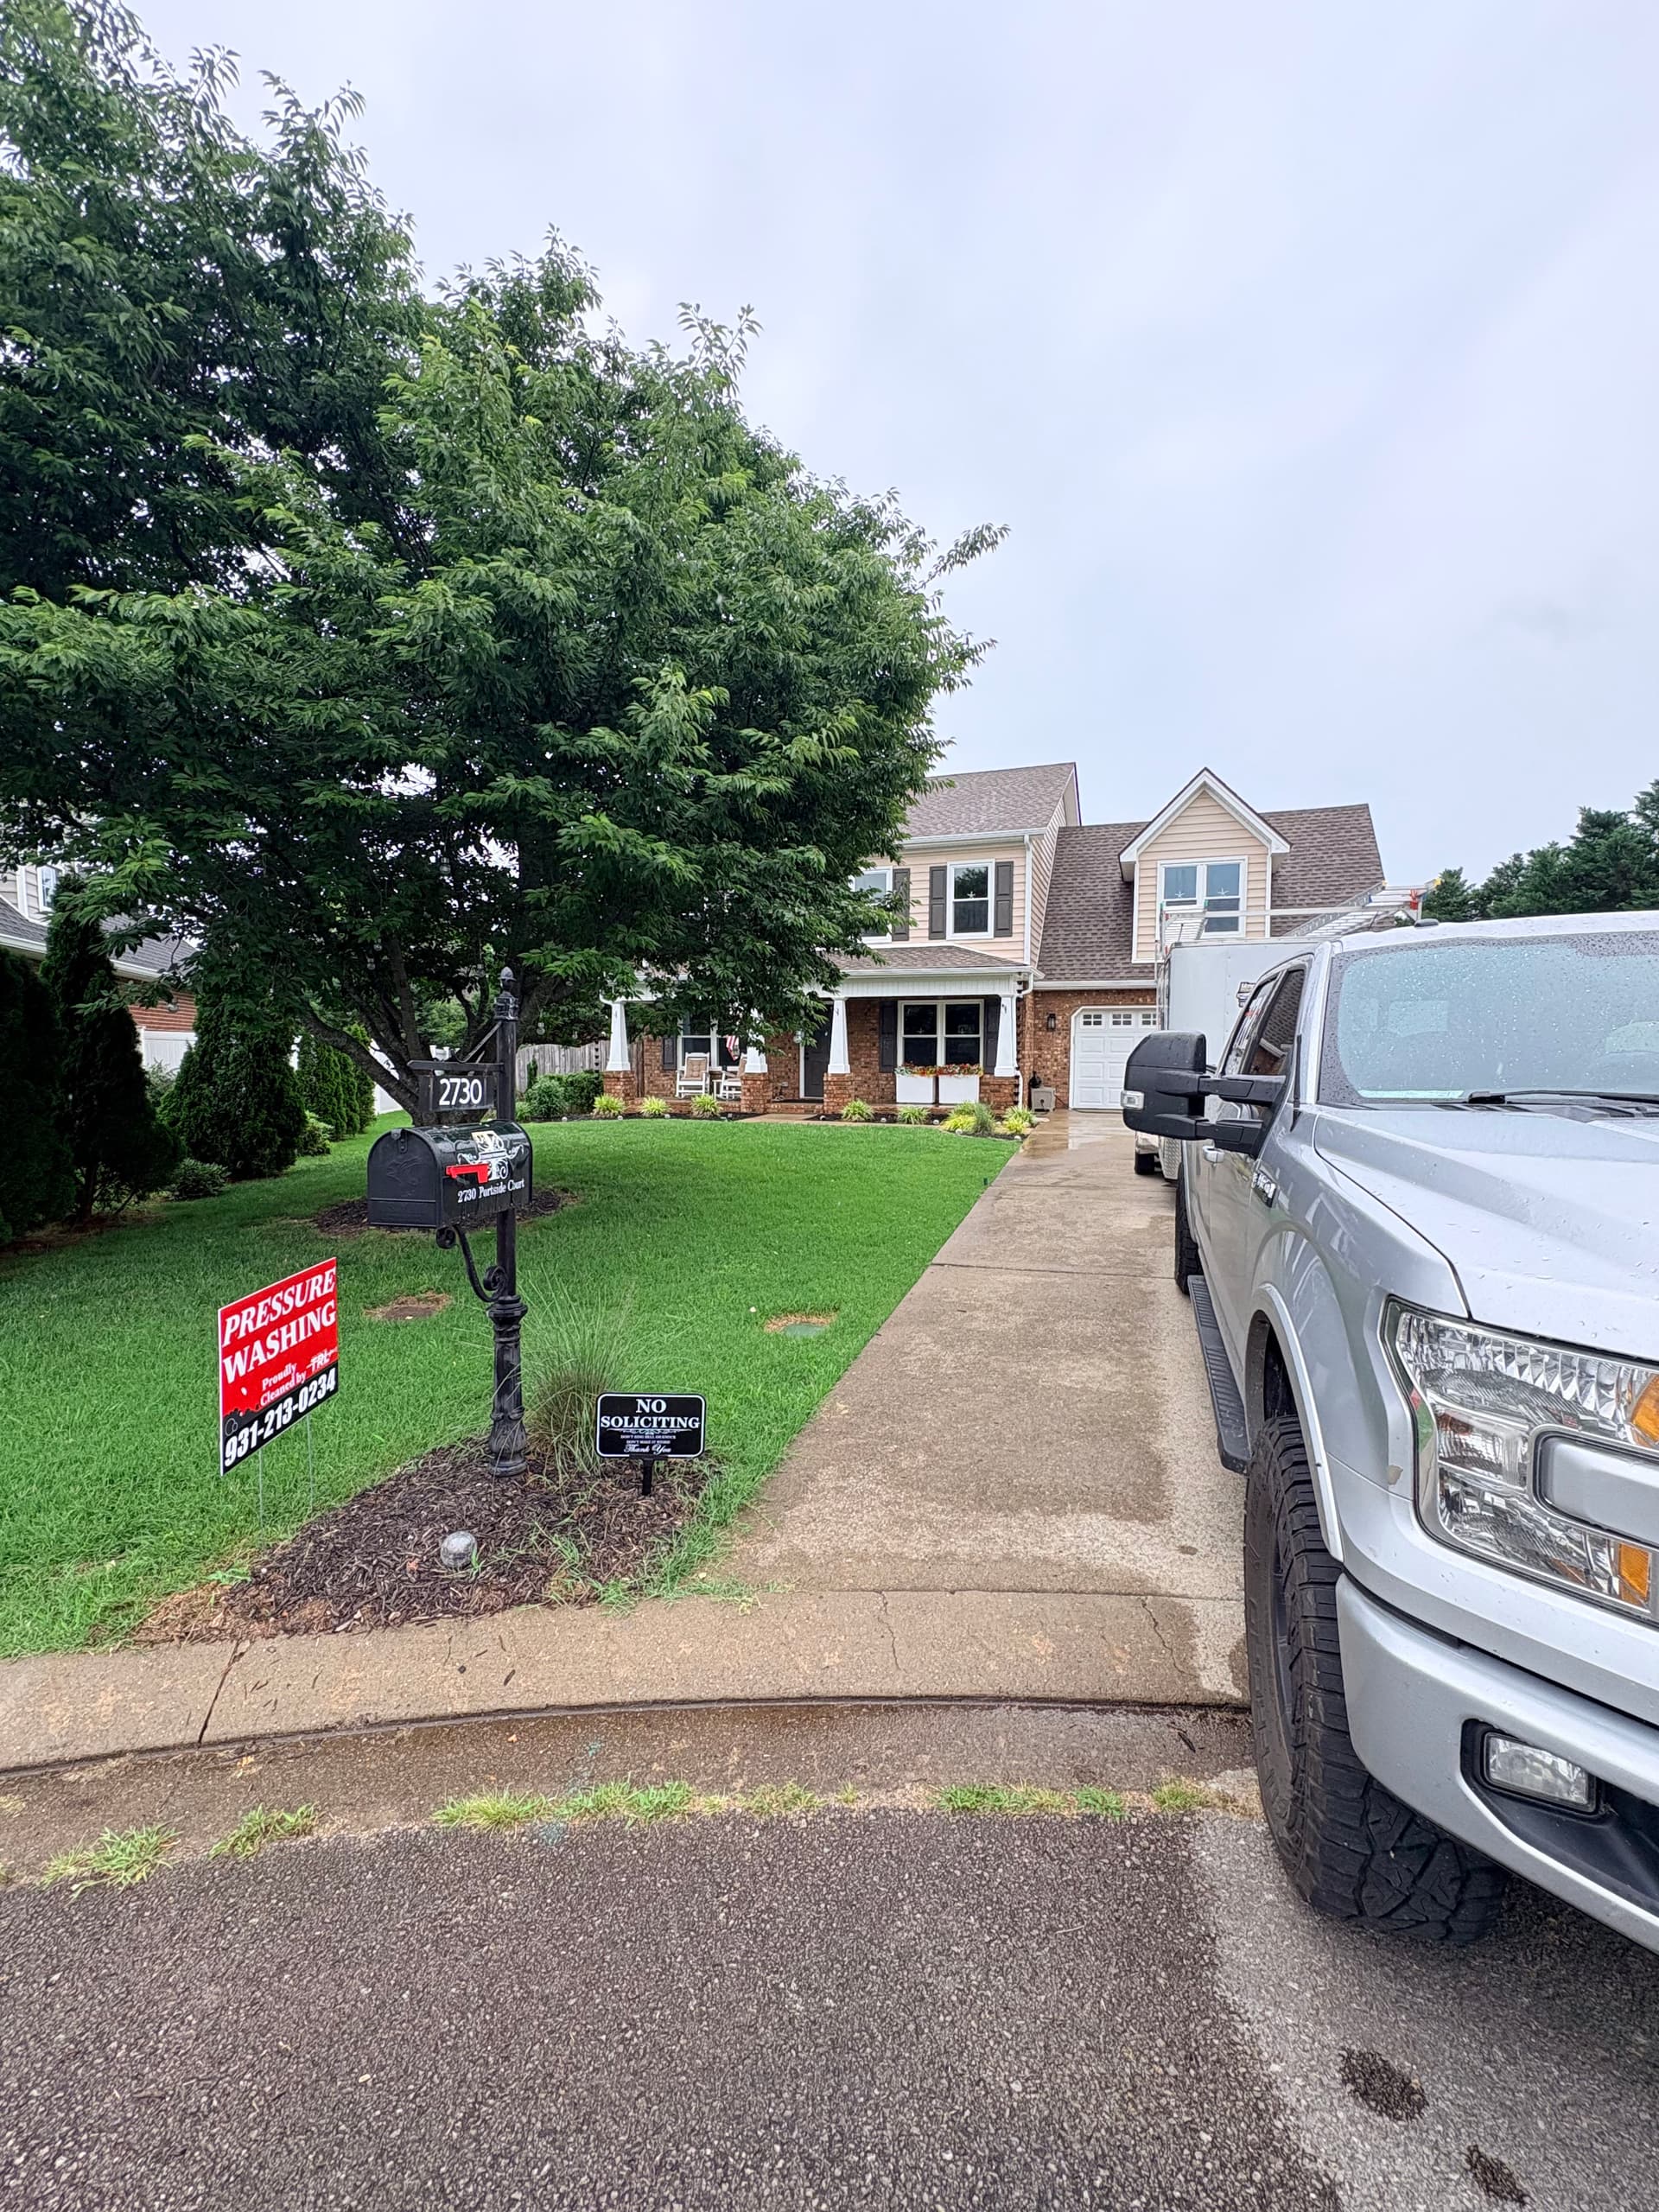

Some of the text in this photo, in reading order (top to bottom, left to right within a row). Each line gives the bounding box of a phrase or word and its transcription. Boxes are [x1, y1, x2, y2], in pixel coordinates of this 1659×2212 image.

[438, 1077, 483, 1106] 2730
[457, 1178, 525, 1204] 2730 Portside Court
[221, 1267, 336, 1349] PRESSURE
[222, 1299, 337, 1385] WASHING
[260, 1376, 296, 1407] Cleaned
[296, 1370, 307, 1384] by
[262, 1363, 297, 1391] Proudly
[225, 1367, 336, 1467] 931-213-0234
[635, 1398, 667, 1414] NO
[601, 1415, 701, 1428] SOLICITING
[624, 1443, 671, 1455] Thank You
